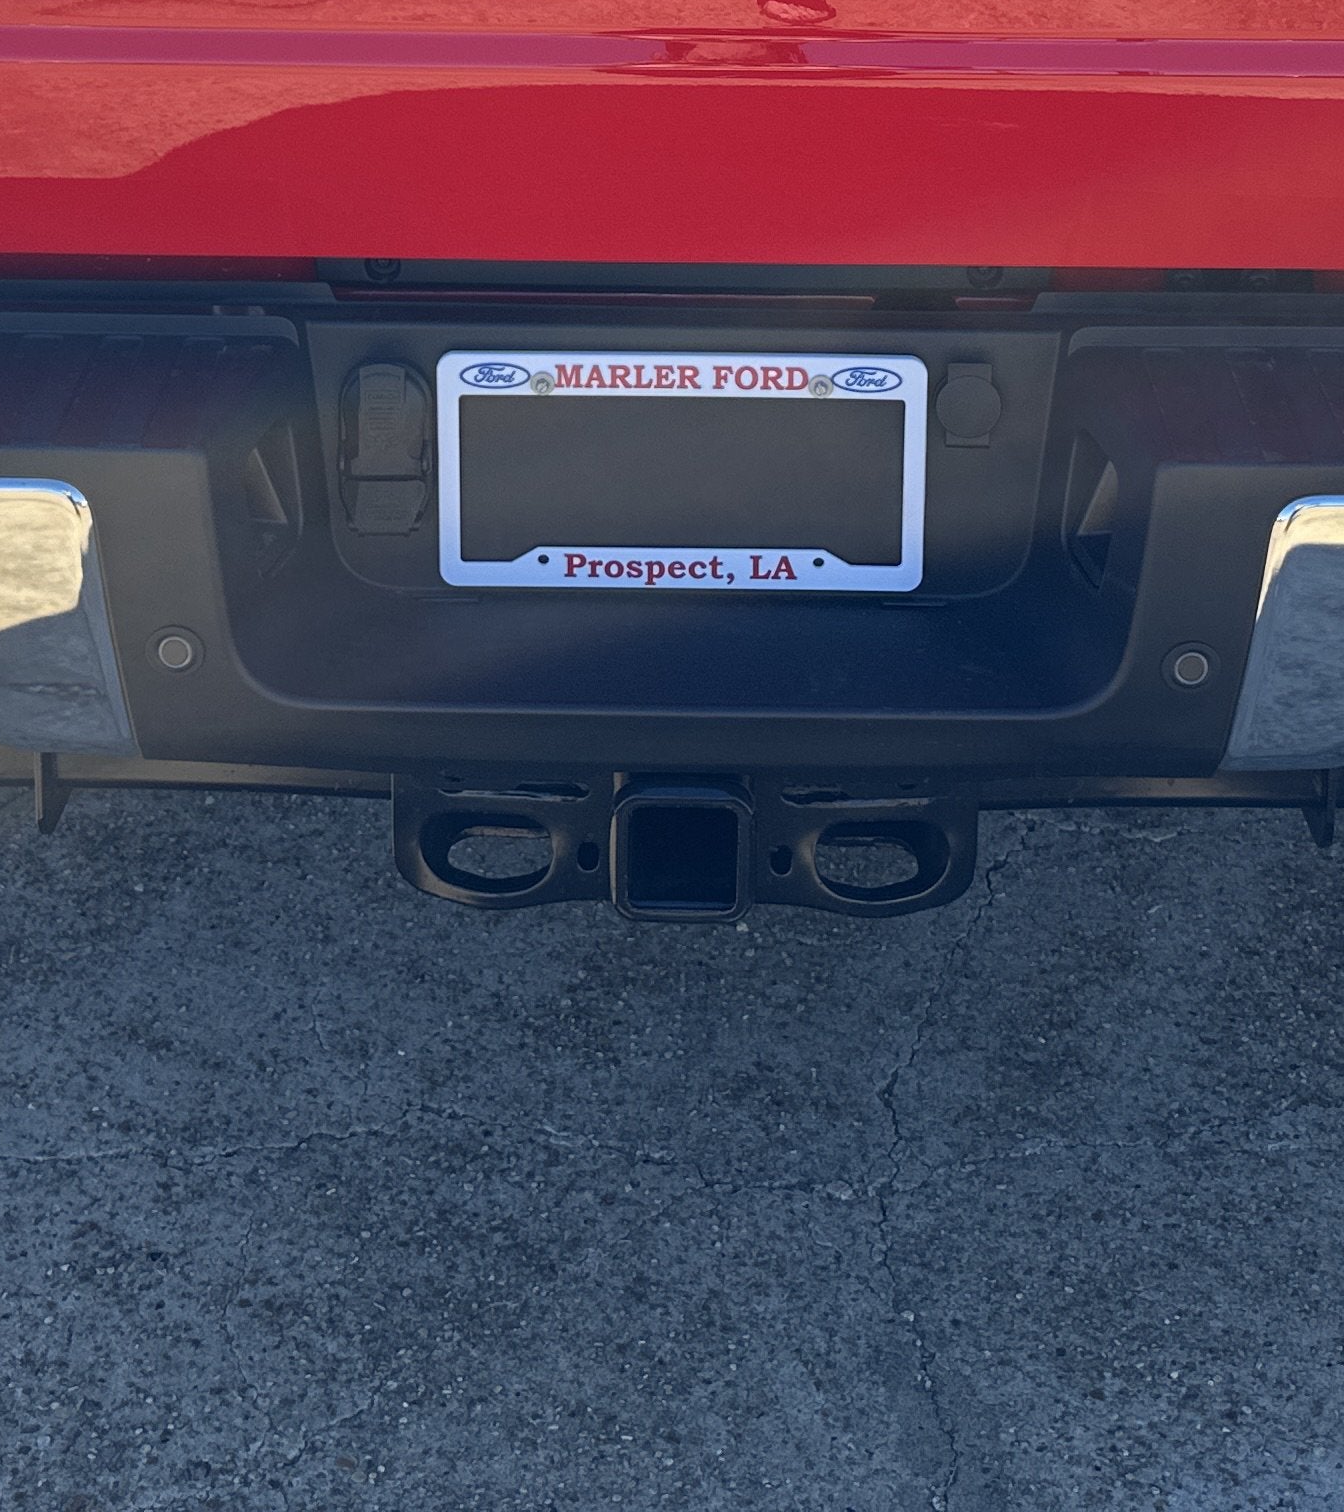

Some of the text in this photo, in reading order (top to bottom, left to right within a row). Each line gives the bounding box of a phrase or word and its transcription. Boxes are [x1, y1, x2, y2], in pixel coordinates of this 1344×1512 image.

[474, 364, 888, 392] Ford MARLER FORD Ford
[563, 553, 798, 585] Prospect, LA
